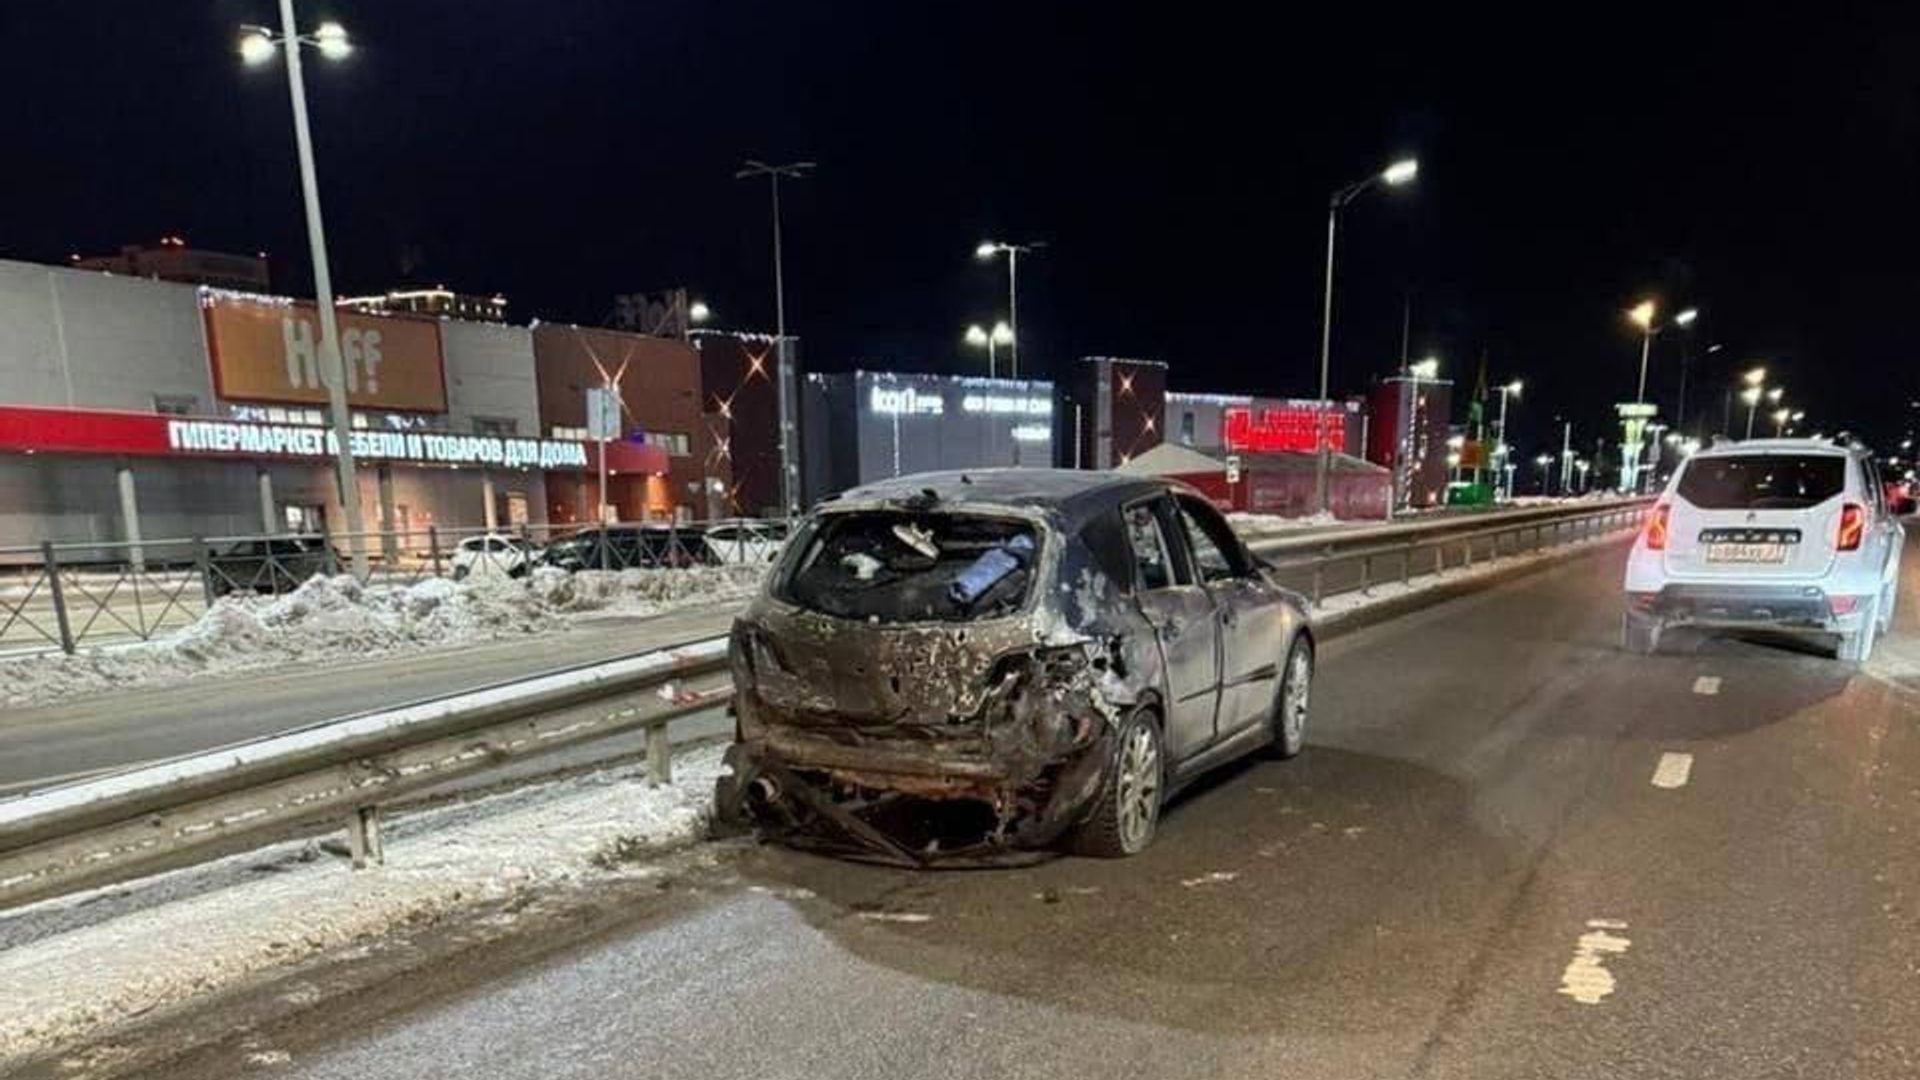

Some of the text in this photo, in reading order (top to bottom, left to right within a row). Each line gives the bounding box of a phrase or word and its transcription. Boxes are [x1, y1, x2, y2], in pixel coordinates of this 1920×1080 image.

[168, 420, 324, 455] ГИПЕРМАРКЕТ
[406, 434, 422, 459] И
[424, 434, 503, 462] ТОВАРОВ
[504, 438, 538, 467] ДЛЯ
[540, 440, 588, 468] ДОМА
